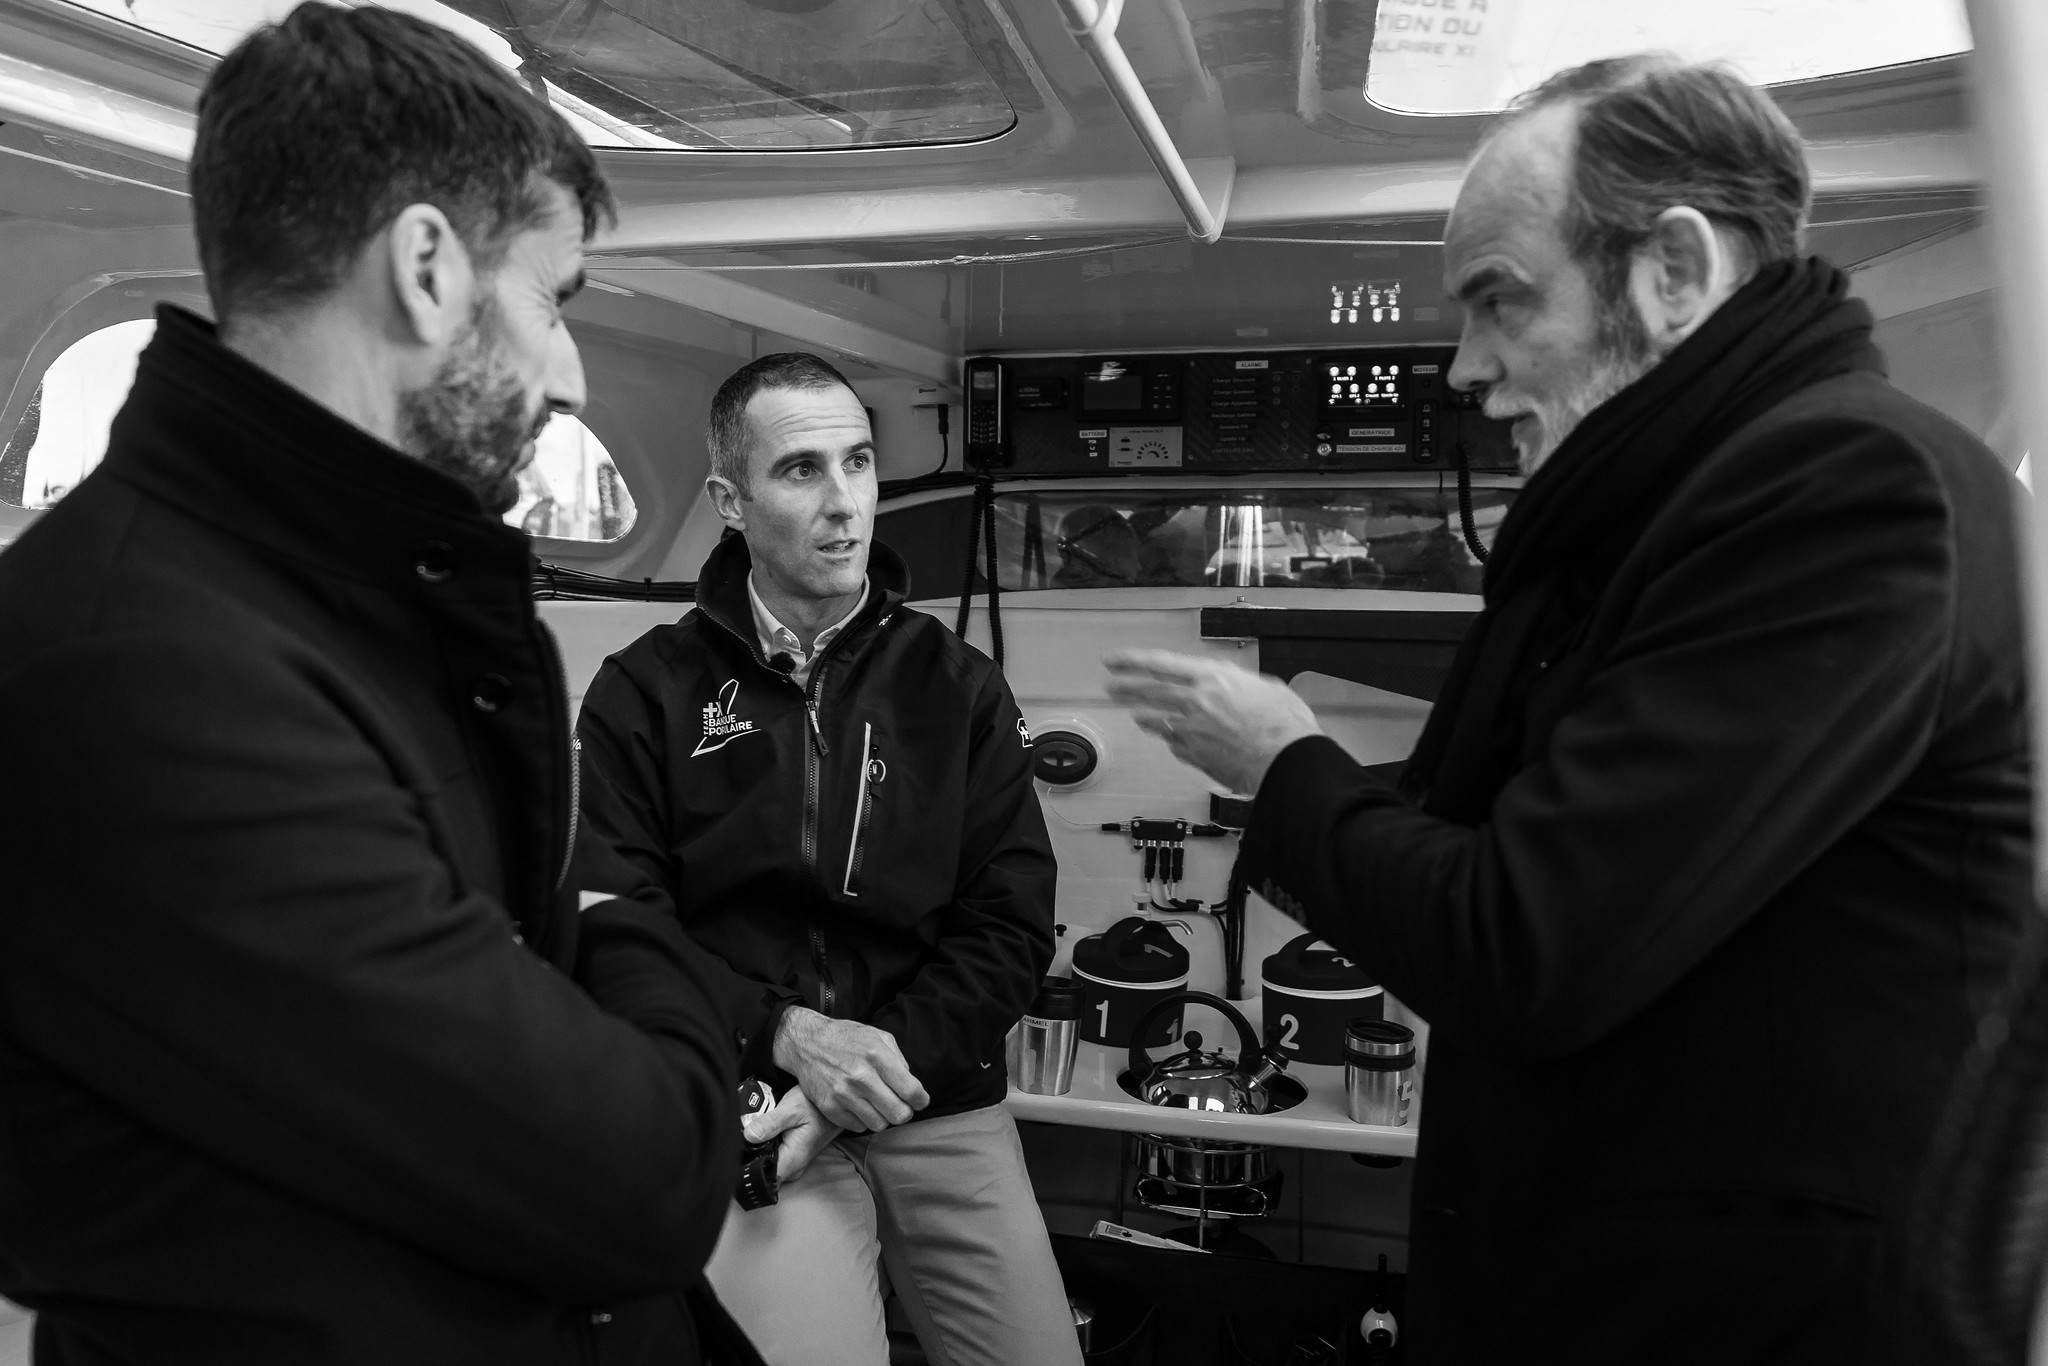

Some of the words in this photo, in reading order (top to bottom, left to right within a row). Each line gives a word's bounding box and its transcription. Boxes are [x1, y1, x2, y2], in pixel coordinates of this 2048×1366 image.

[1442, 16, 1483, 36] DU
[708, 714, 737, 727] BAUE
[708, 721, 753, 736] POLAIRE
[1095, 1000, 1109, 1038] 1
[1279, 1013, 1300, 1050] 2
